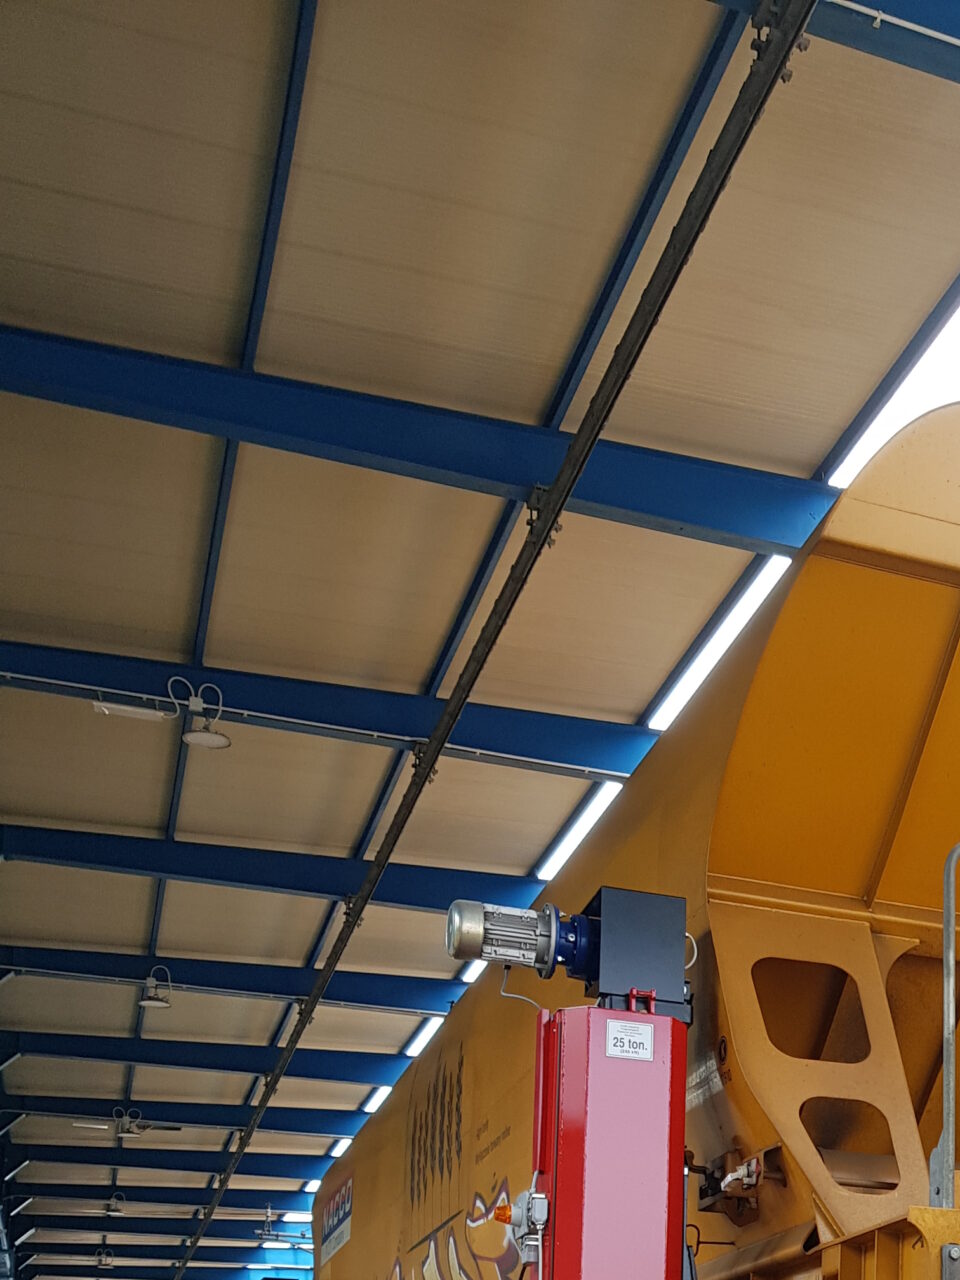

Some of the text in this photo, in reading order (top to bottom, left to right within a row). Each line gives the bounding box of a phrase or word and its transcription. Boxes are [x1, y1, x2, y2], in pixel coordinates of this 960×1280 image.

[613, 1036, 648, 1050] 25 ton.
[322, 1177, 353, 1238] NACCO
